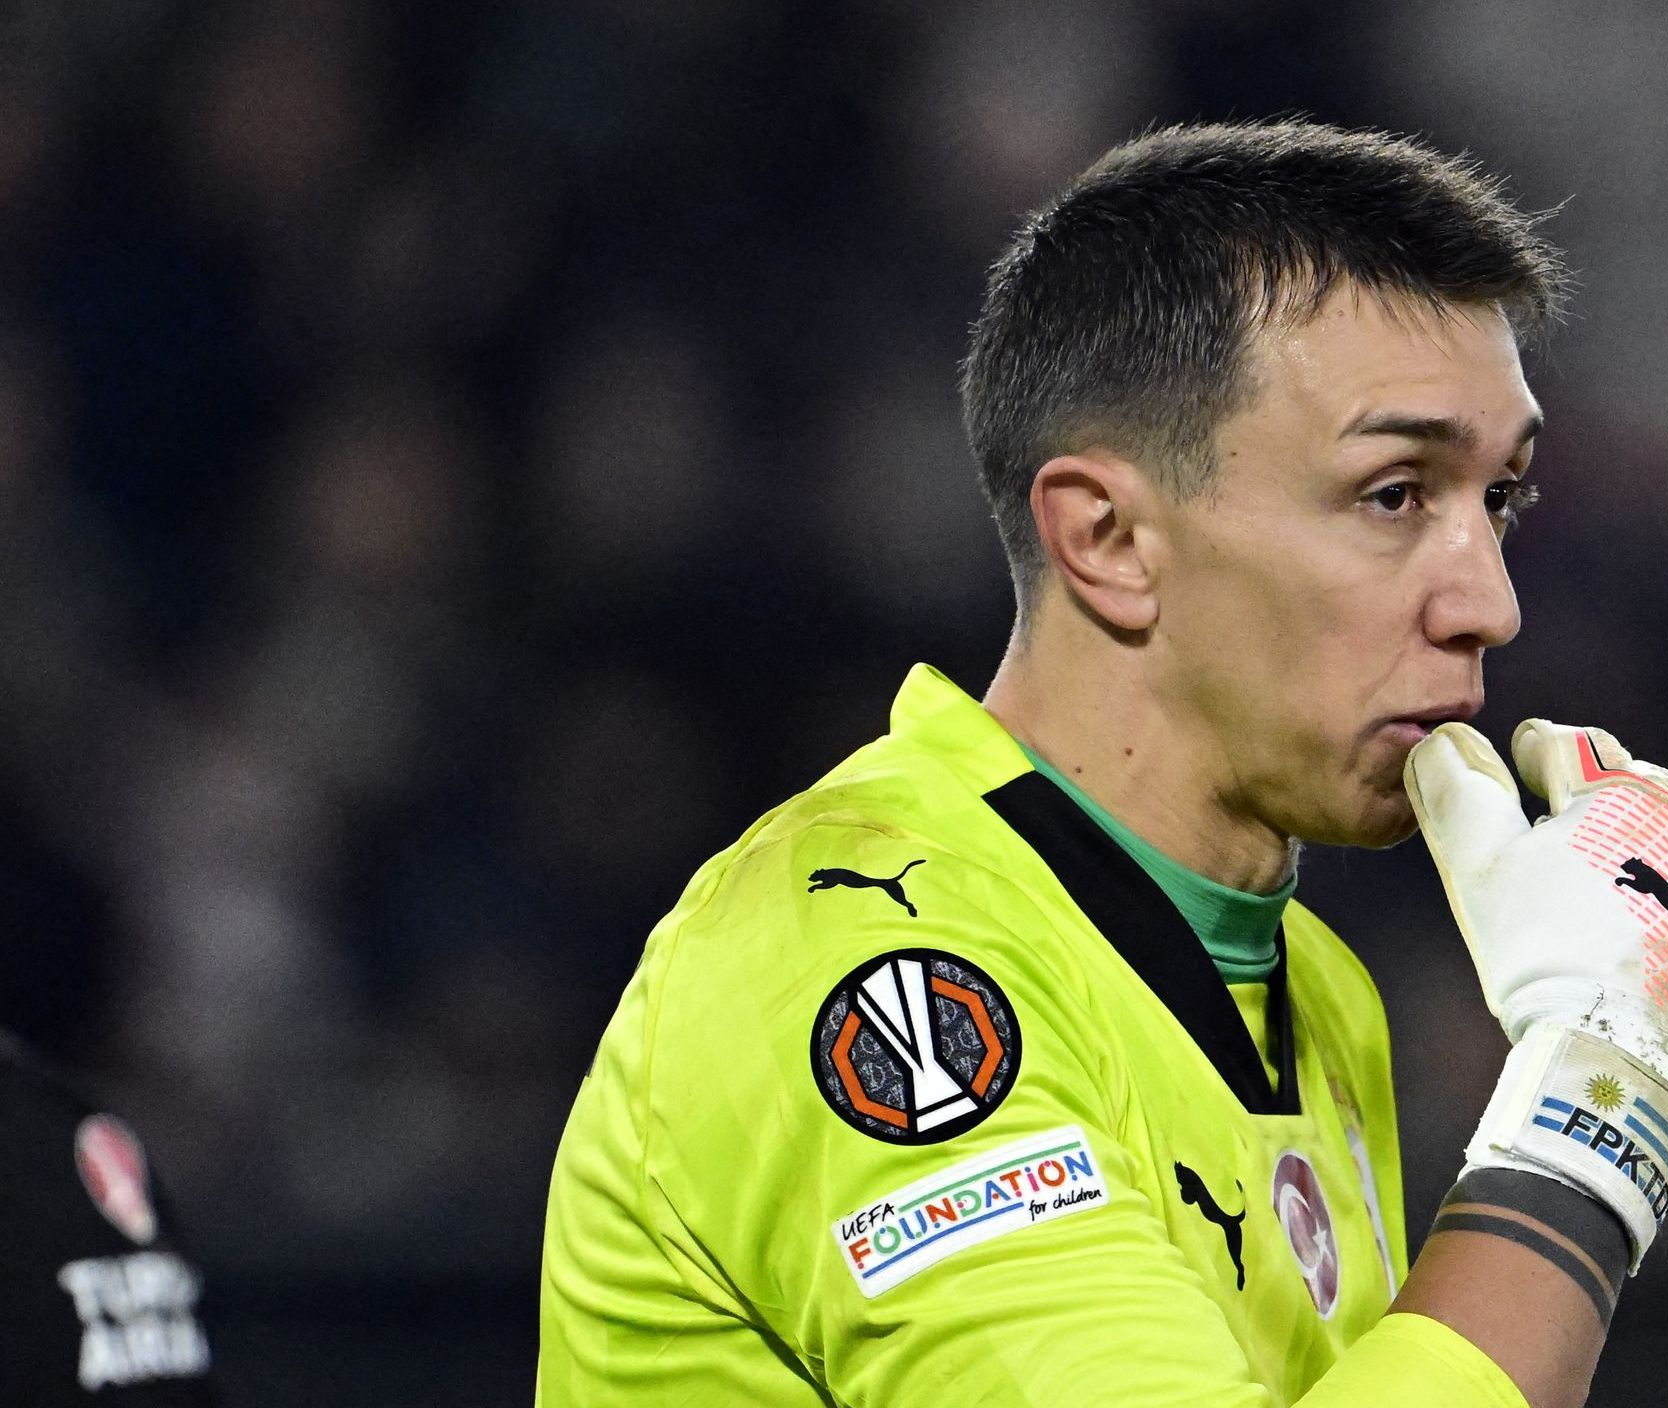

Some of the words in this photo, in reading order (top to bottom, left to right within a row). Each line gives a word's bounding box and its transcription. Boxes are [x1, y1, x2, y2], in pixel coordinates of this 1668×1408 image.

[842, 1202, 896, 1241] UEFA
[1029, 1199, 1047, 1221] for
[1053, 1186, 1102, 1210] children
